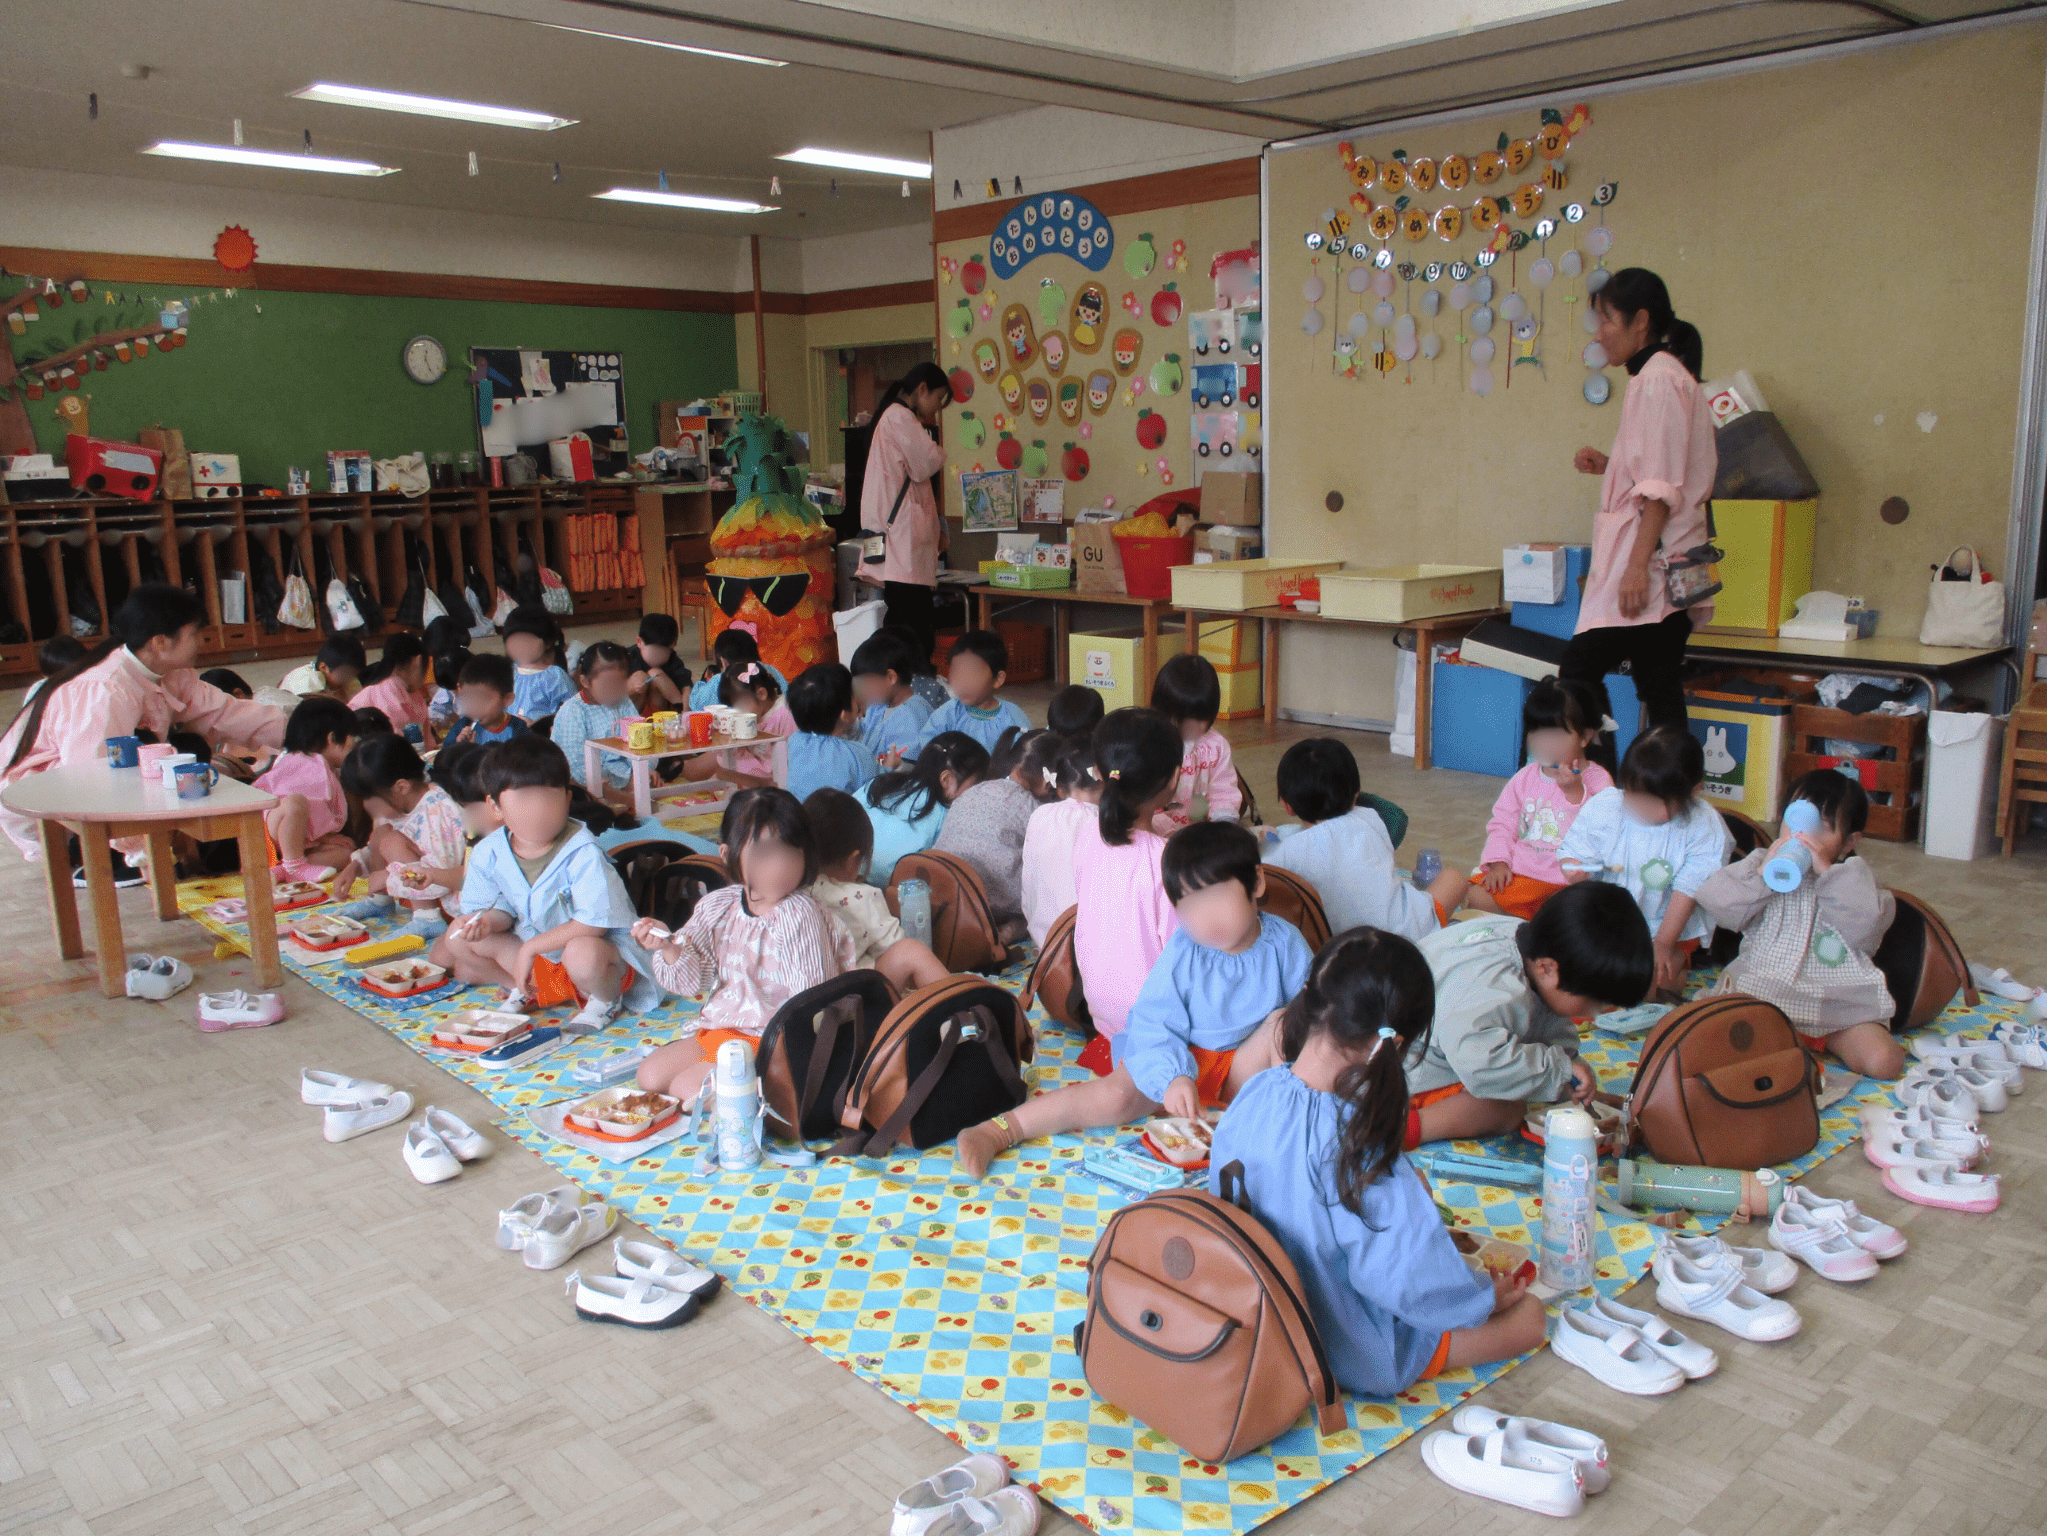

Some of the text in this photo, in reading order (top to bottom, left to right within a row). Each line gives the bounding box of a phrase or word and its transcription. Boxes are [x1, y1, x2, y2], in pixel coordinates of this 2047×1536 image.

[1356, 133, 1562, 185] おたんじょうび
[1376, 193, 1535, 233] おめでとう
[1454, 264, 1465, 277] 10
[1083, 546, 1103, 562] GU
